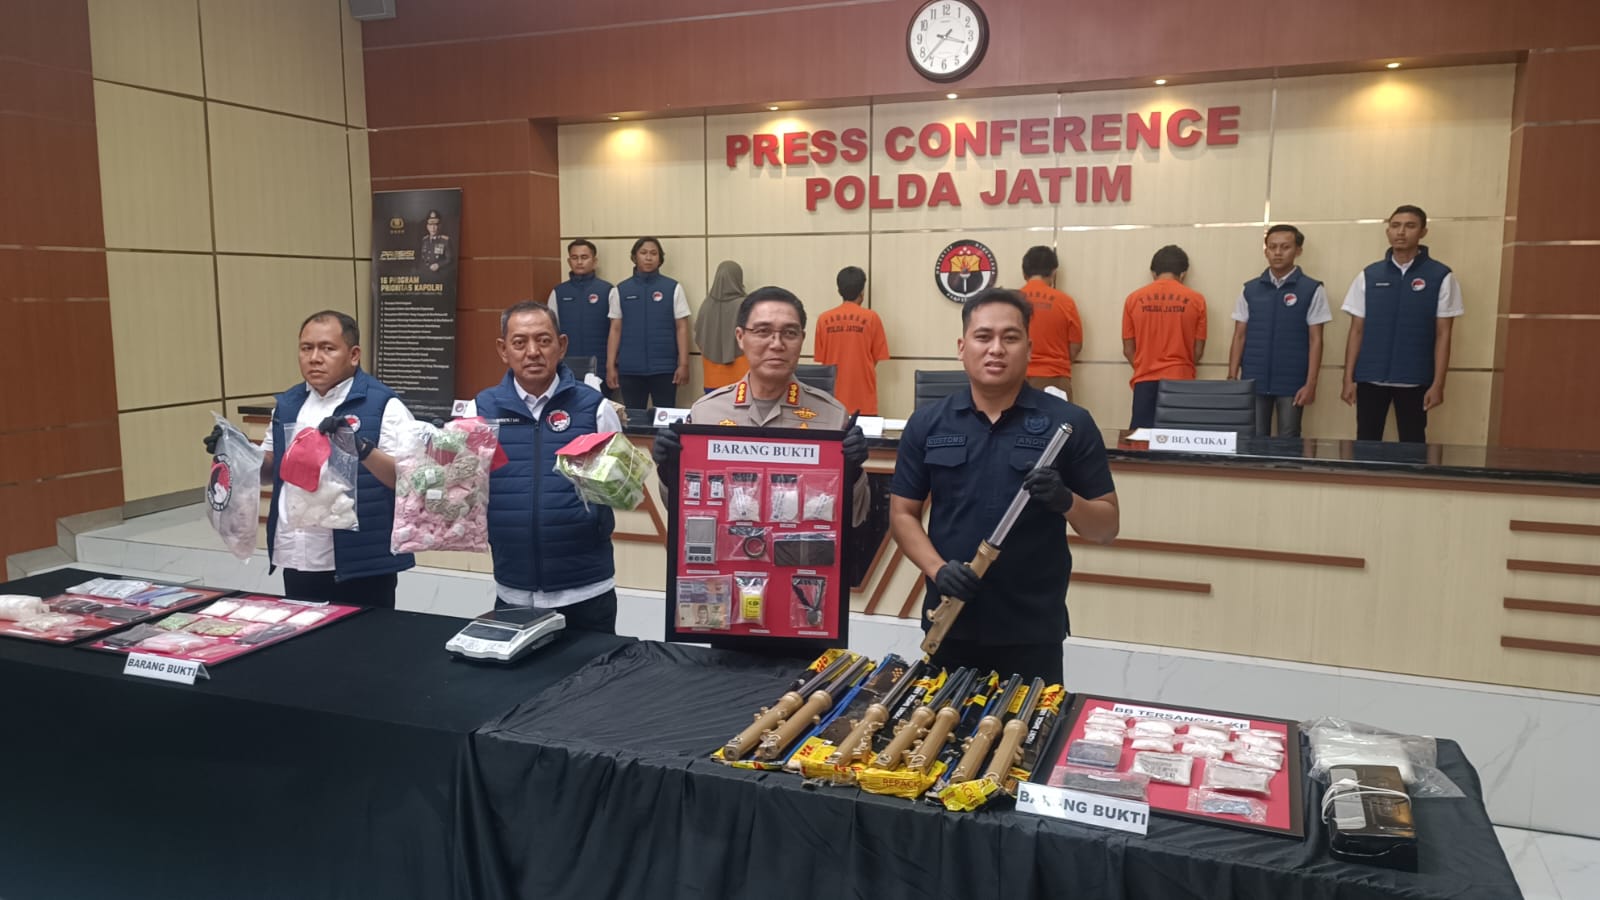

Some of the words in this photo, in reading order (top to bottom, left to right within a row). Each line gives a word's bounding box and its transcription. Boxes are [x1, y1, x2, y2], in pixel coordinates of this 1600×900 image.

[931, 9, 937, 20] 11
[942, 4, 951, 16] 12
[958, 7, 961, 18] 1
[920, 19, 928, 31] 10
[965, 16, 971, 28] 2
[917, 33, 923, 45] 9
[968, 30, 974, 41] 3
[920, 47, 926, 58] 8
[963, 44, 969, 56] 4
[941, 59, 947, 70] 6
[954, 56, 960, 65] 5
[726, 128, 868, 168] PRESS
[885, 106, 1241, 162] CONFERENCE
[806, 172, 962, 212] POLDA
[980, 165, 1132, 206] JATIM
[389, 276, 420, 284] PROGRAM
[380, 284, 413, 292] PRIORITAS
[414, 284, 443, 292] KAPOLRI
[928, 436, 964, 445] CUSTOMS
[1171, 435, 1191, 444] BEA
[1193, 437, 1227, 446] CUKAI
[712, 443, 769, 456] BARANG
[773, 446, 815, 458] BUKTI
[127, 658, 166, 672] BARANG
[166, 664, 196, 677] BUKTI
[1093, 804, 1147, 825] BUKTI
